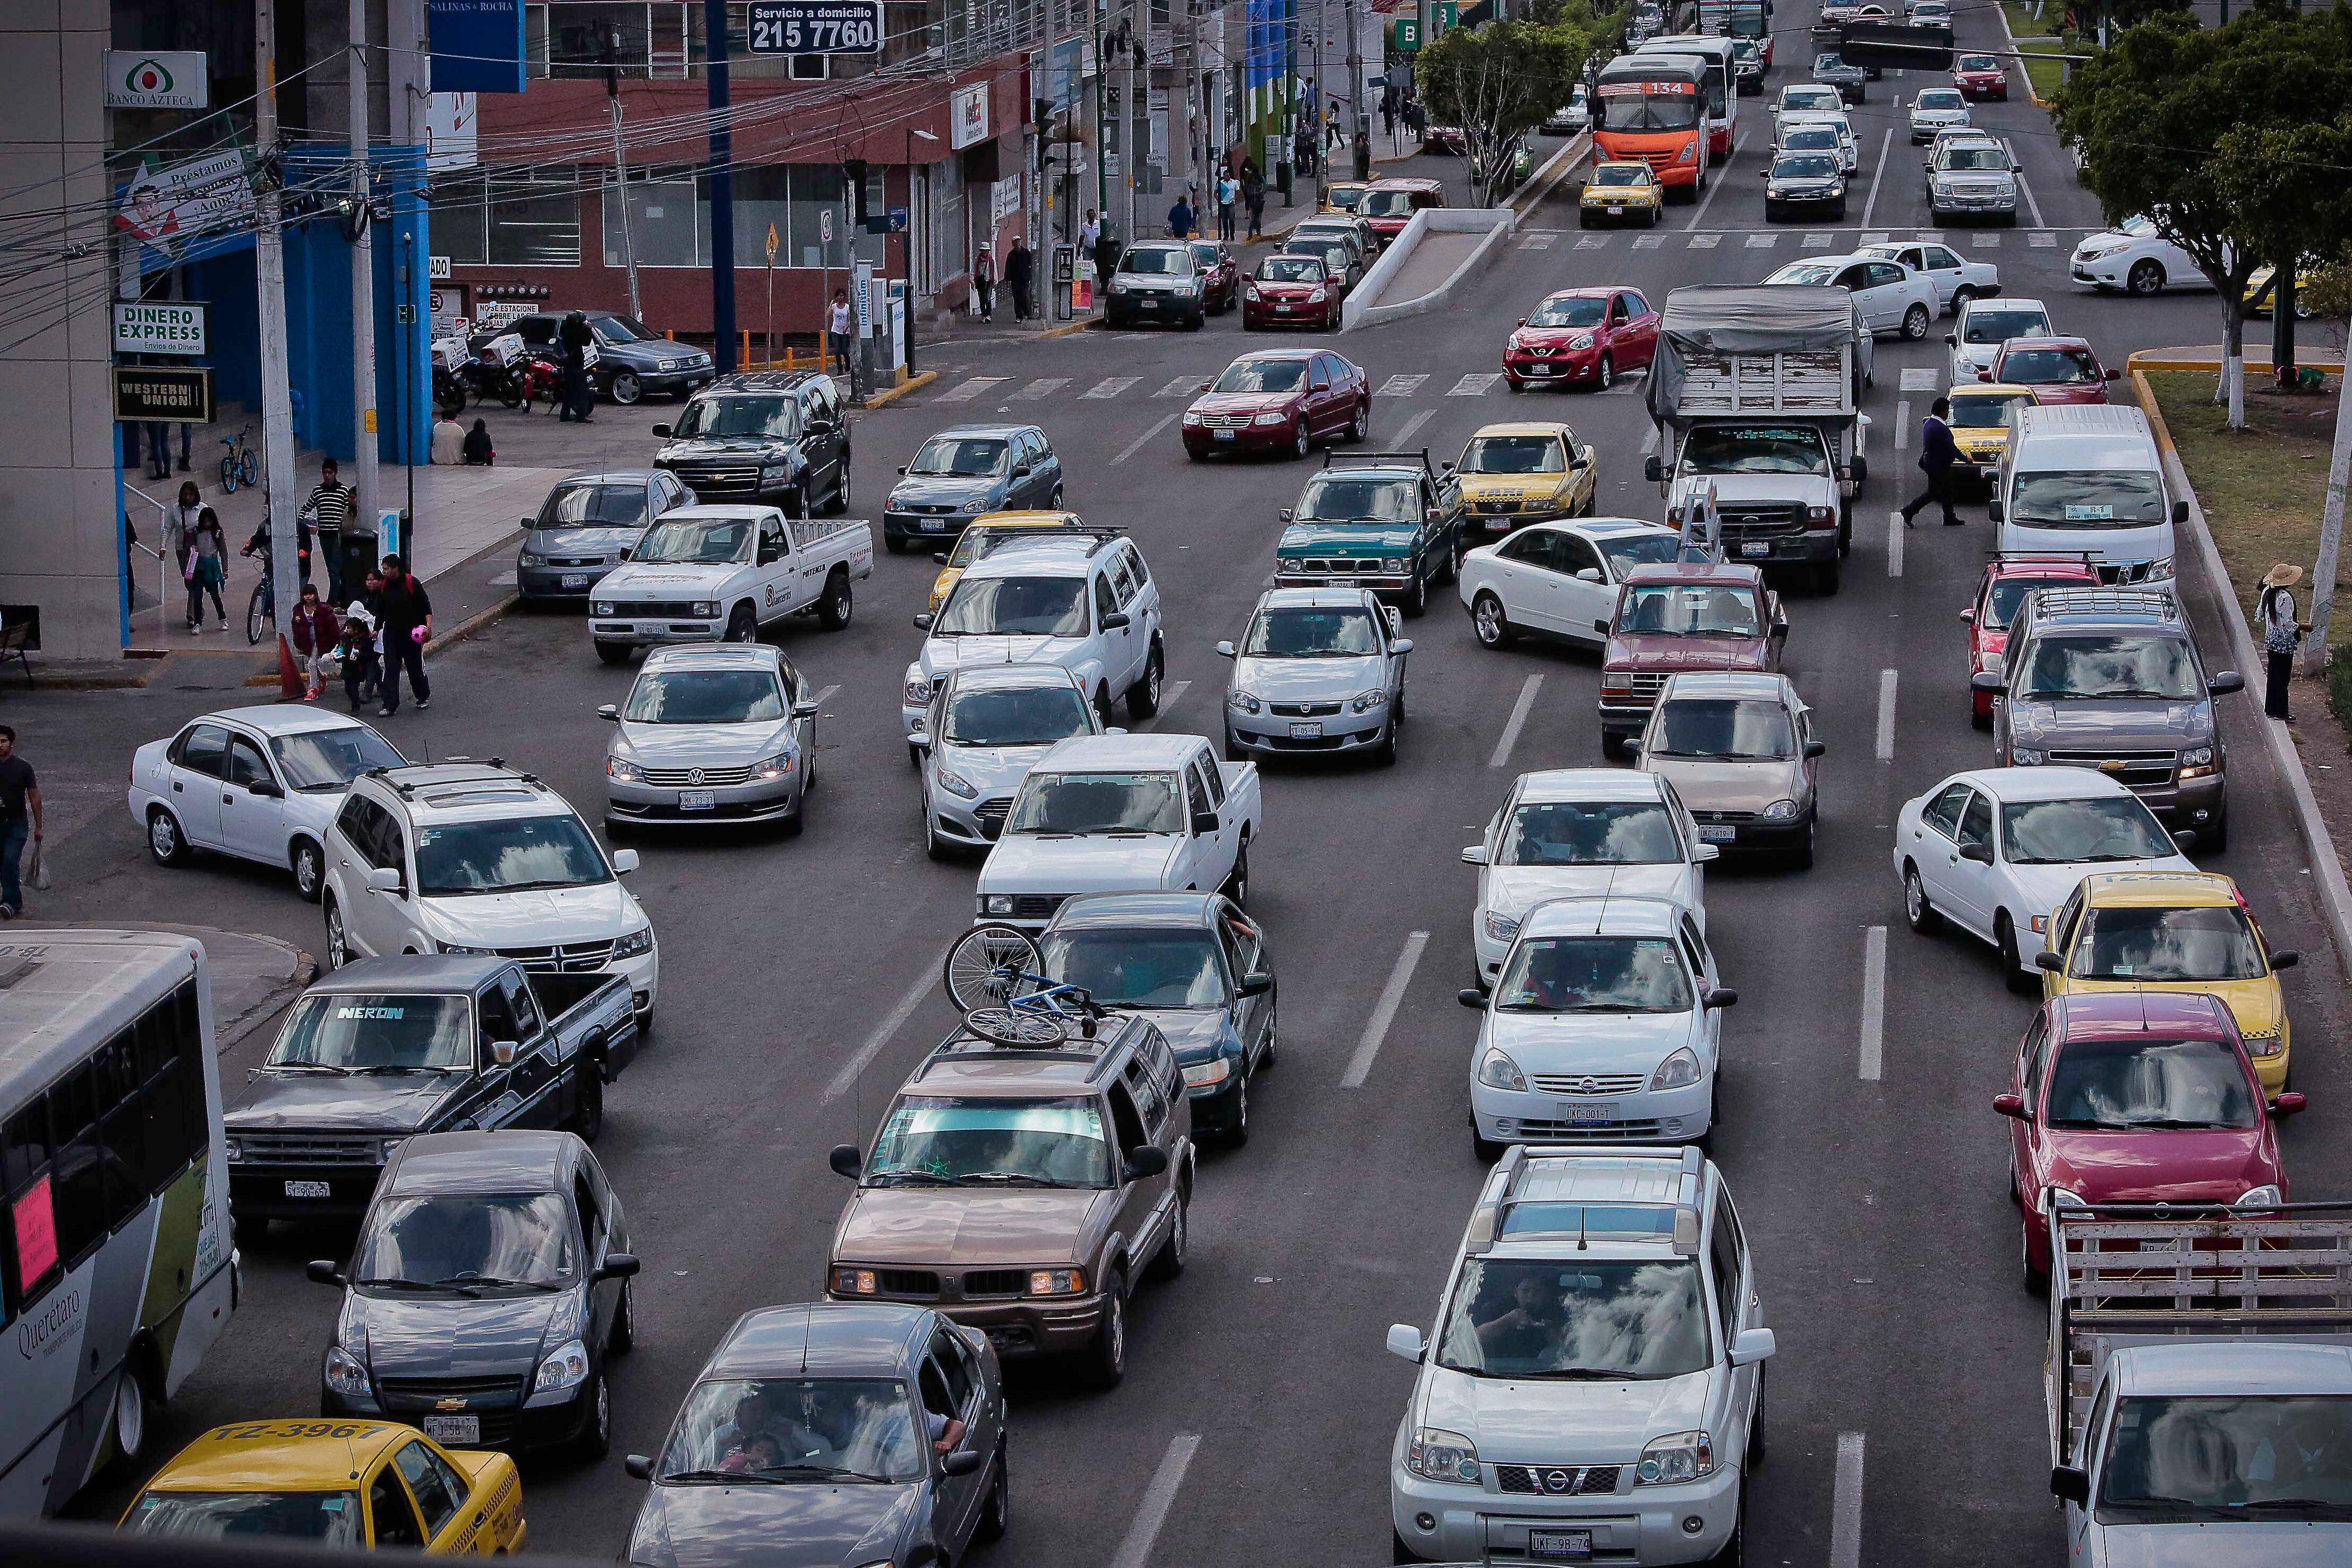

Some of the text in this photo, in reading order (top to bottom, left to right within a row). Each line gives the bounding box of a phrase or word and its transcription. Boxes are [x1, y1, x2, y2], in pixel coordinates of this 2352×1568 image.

[430, 2, 470, 11] SALINAS
[480, 2, 513, 11] ROCHA
[755, 8, 803, 18] Servicio
[817, 7, 871, 18] domicilio
[754, 21, 873, 47] 215 7760
[1405, 25, 1415, 41] B
[1651, 83, 1683, 94] 134
[107, 92, 194, 106] BANCO AZTECA
[171, 157, 238, 184] Préstamos
[124, 307, 193, 324] DINERO
[118, 324, 200, 340] EXPRESS
[122, 383, 188, 395] WESTERN
[142, 395, 188, 406] UNION
[1478, 489, 1523, 497] TAXI
[802, 564, 826, 579] POTENZA
[1567, 1109, 1609, 1119] UKC-001-T
[19, 1290, 80, 1360] Querétaro
[214, 1423, 390, 1441] TZ-3967
[1533, 1537, 1589, 1550] UKF-98-74
